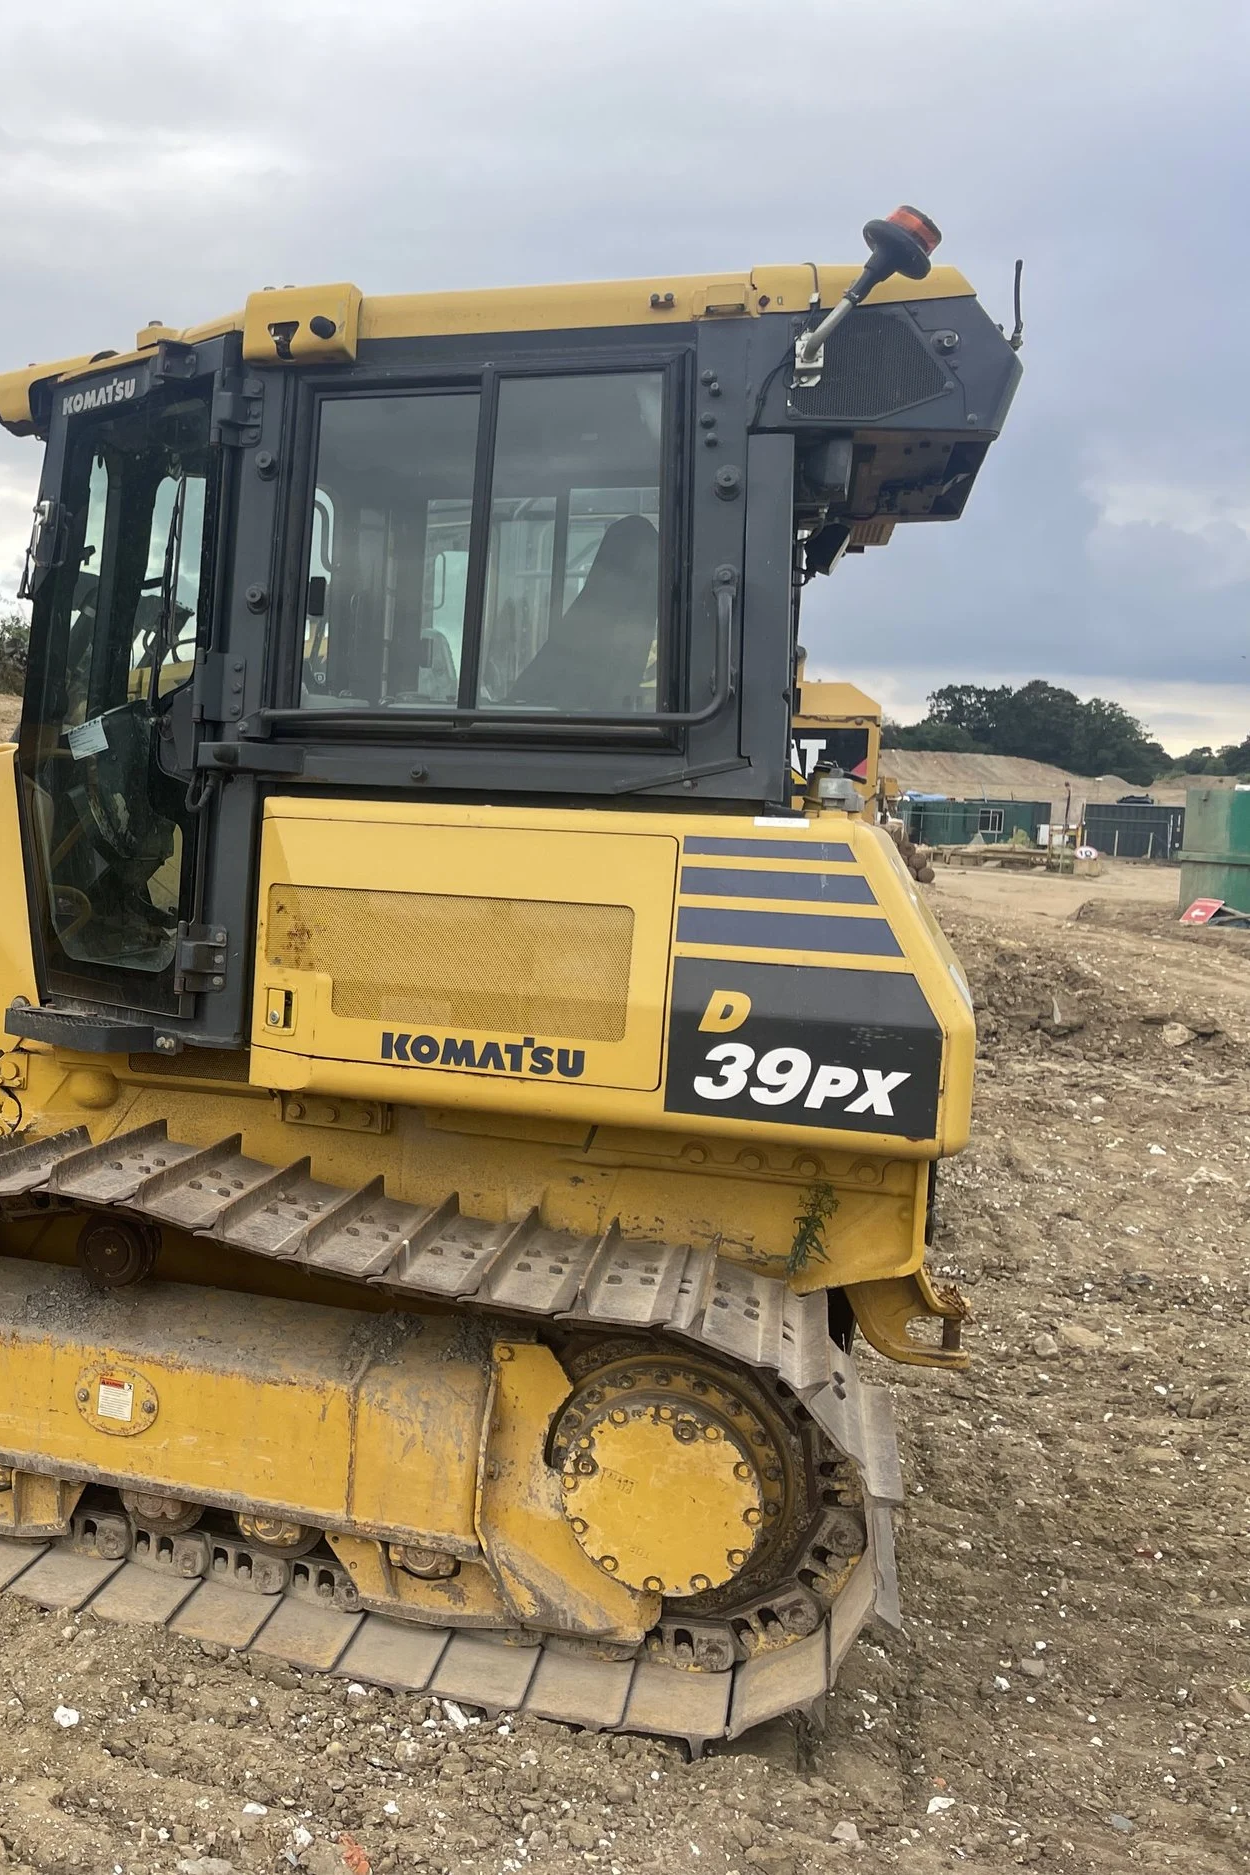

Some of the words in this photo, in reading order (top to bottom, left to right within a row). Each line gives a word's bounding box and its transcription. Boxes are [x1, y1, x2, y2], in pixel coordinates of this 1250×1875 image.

[62, 378, 136, 416] KOMATSU
[1079, 849, 1093, 858] 10
[698, 989, 752, 1034] D
[381, 1031, 586, 1078] KOMATSU
[693, 1042, 912, 1117] 39PX
